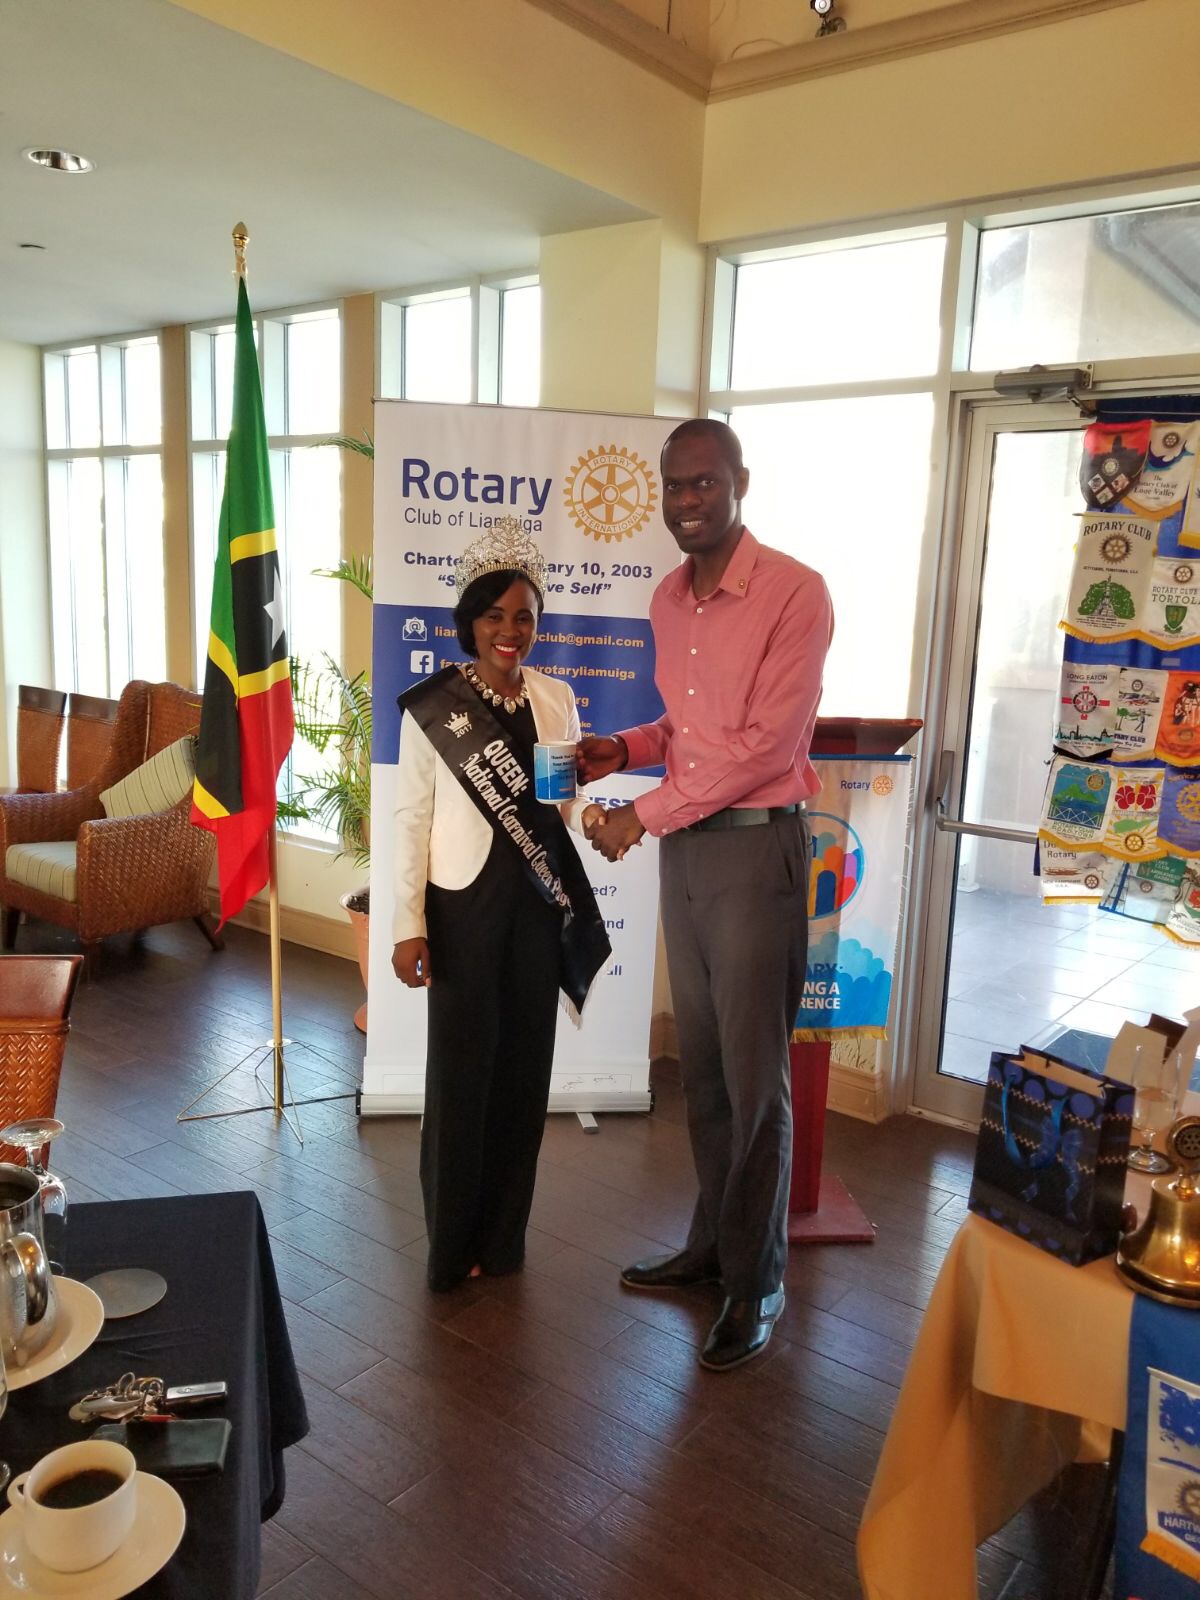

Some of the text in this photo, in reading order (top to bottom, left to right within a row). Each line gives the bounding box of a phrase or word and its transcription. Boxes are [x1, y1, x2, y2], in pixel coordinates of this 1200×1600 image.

[593, 455, 632, 467] ROTARY
[402, 458, 552, 515] Rotary
[404, 507, 442, 525] Club
[448, 511, 464, 526] of
[578, 508, 642, 534] INTERNATIONAL
[1083, 521, 1152, 541] ROTARY CLUB
[581, 562, 605, 578] 10,
[611, 564, 653, 579] 2003
[1152, 594, 1200, 604] TORTOL
[454, 723, 474, 739] 2017
[483, 739, 530, 798] QUEEN:
[840, 779, 870, 791] Rotary
[459, 752, 507, 812] National
[498, 804, 543, 860] Carnival
[1047, 850, 1077, 860] Rotary
[829, 981, 840, 995] A
